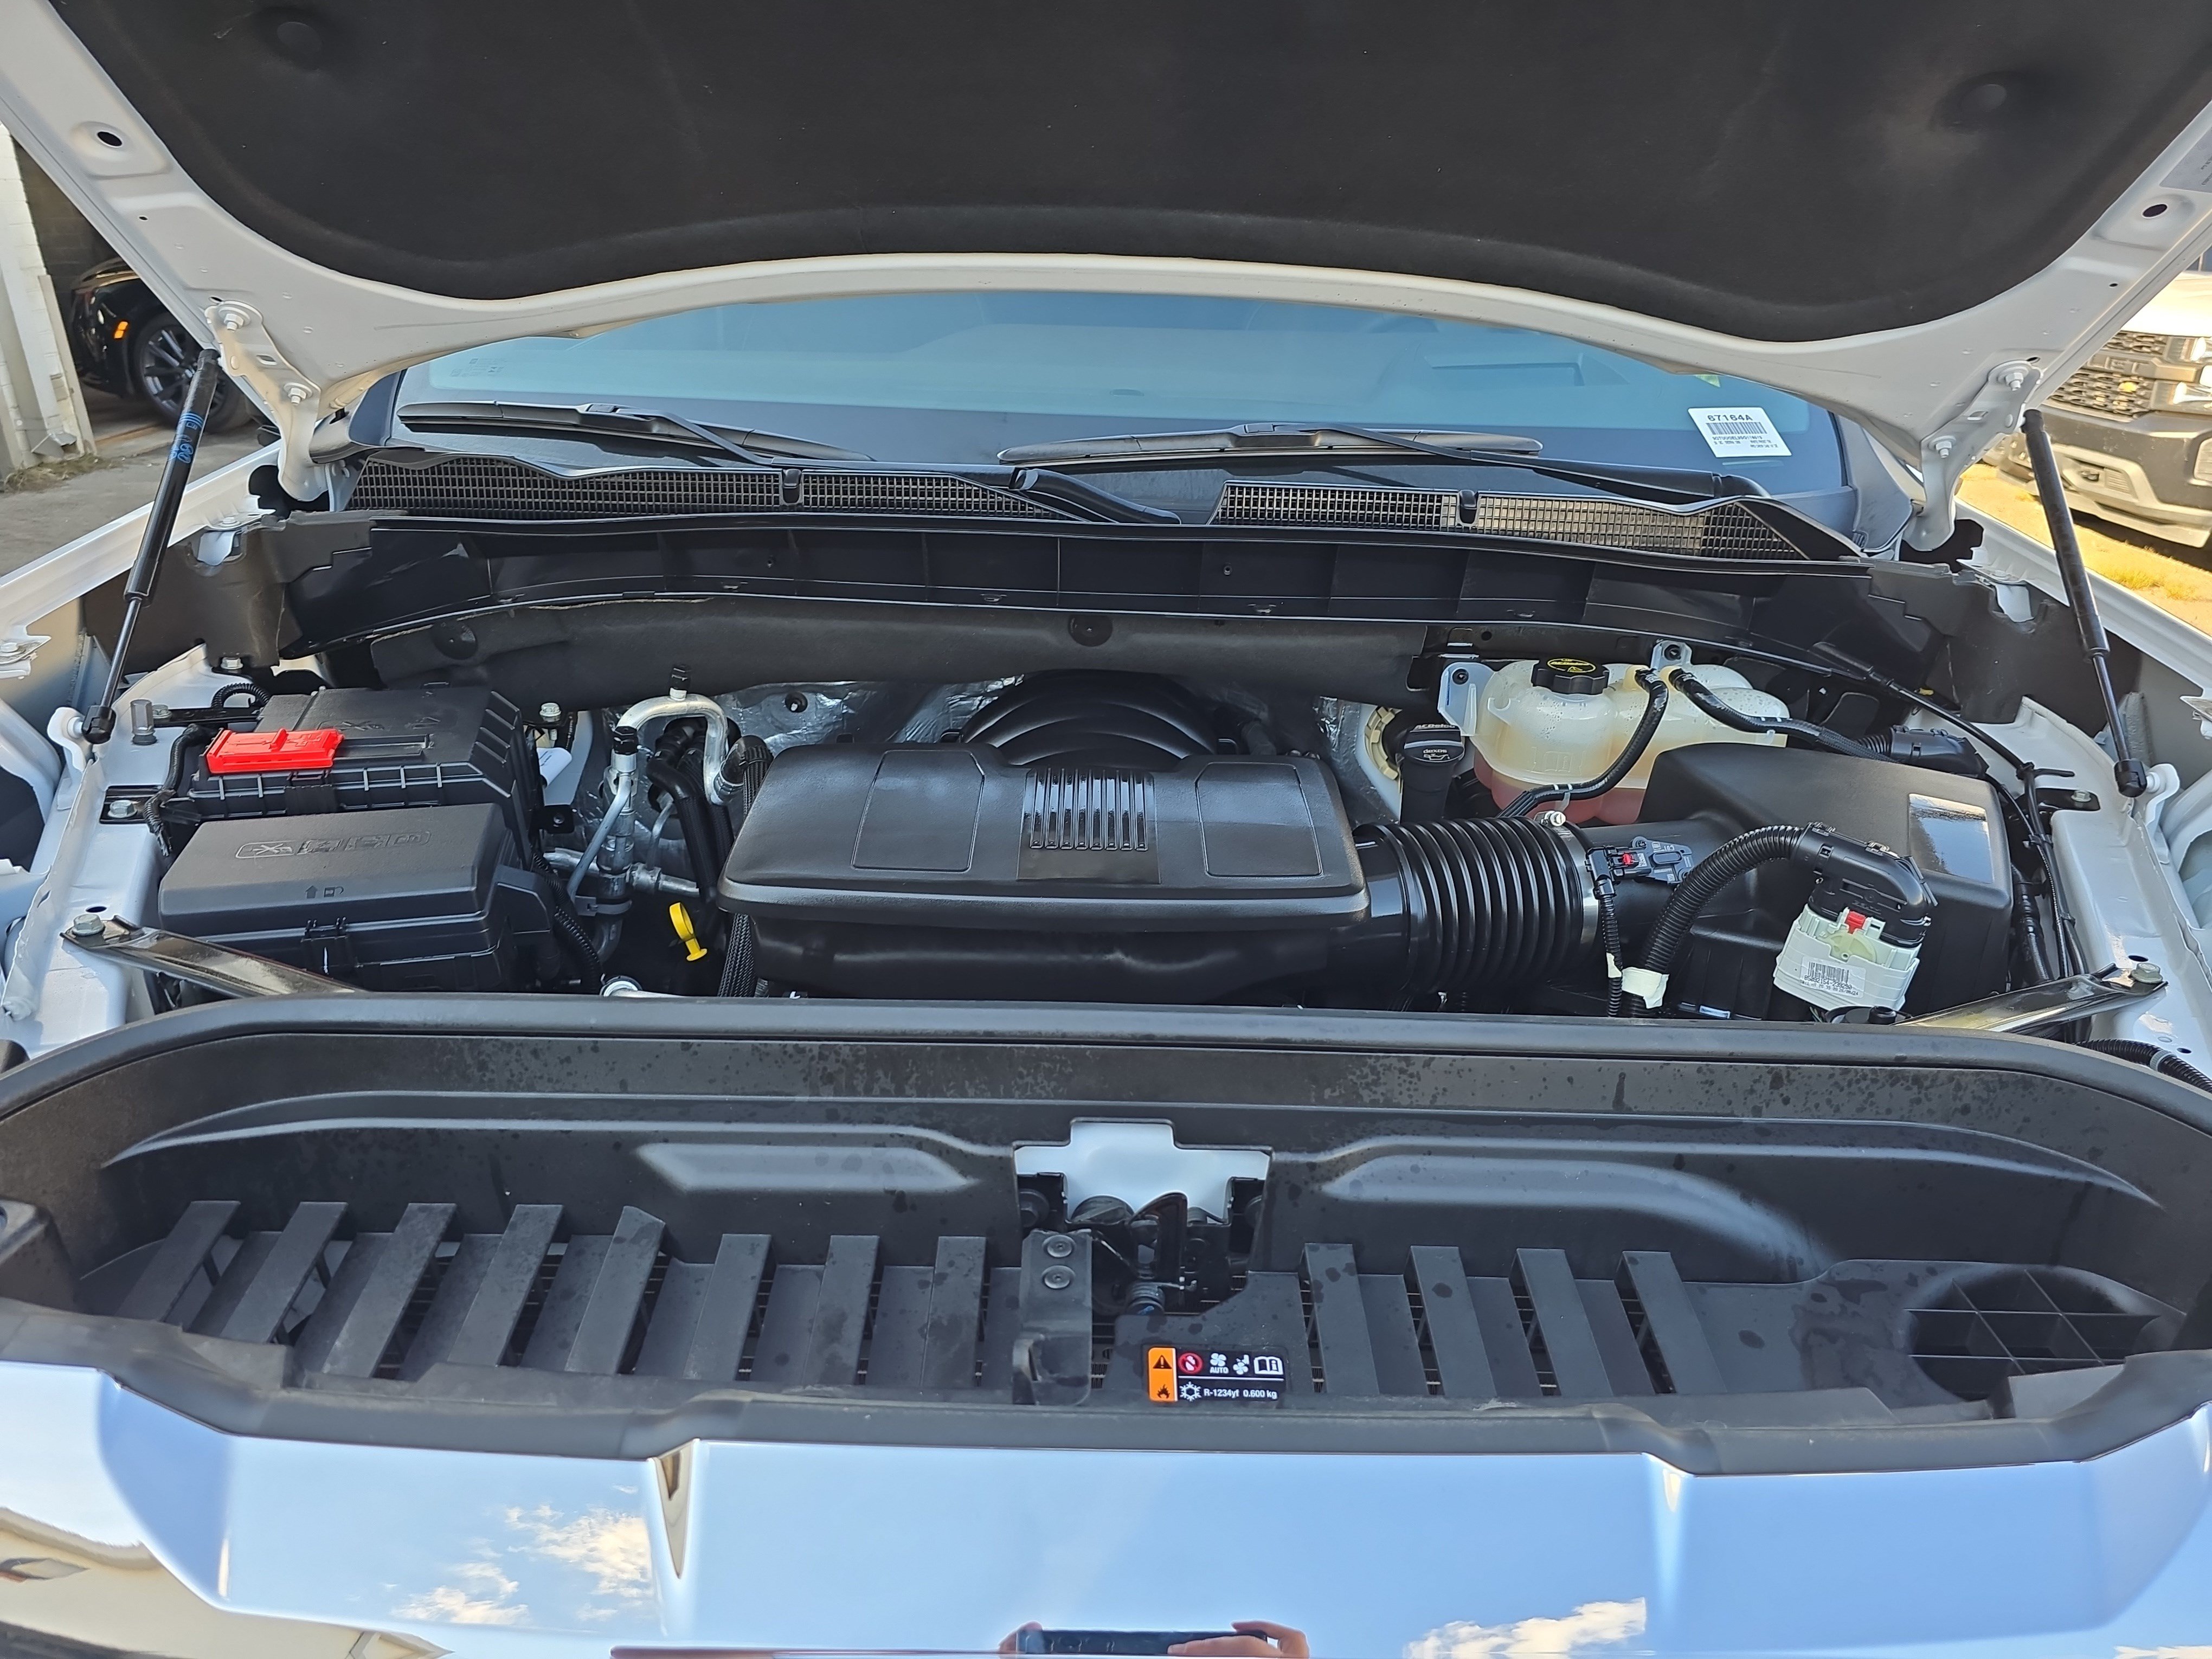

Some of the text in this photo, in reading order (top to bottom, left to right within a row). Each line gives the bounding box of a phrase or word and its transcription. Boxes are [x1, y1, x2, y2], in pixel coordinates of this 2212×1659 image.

[1210, 1366, 1229, 1374] AUTO
[1204, 1388, 1278, 1399] R-1234yf 0.600 kg
